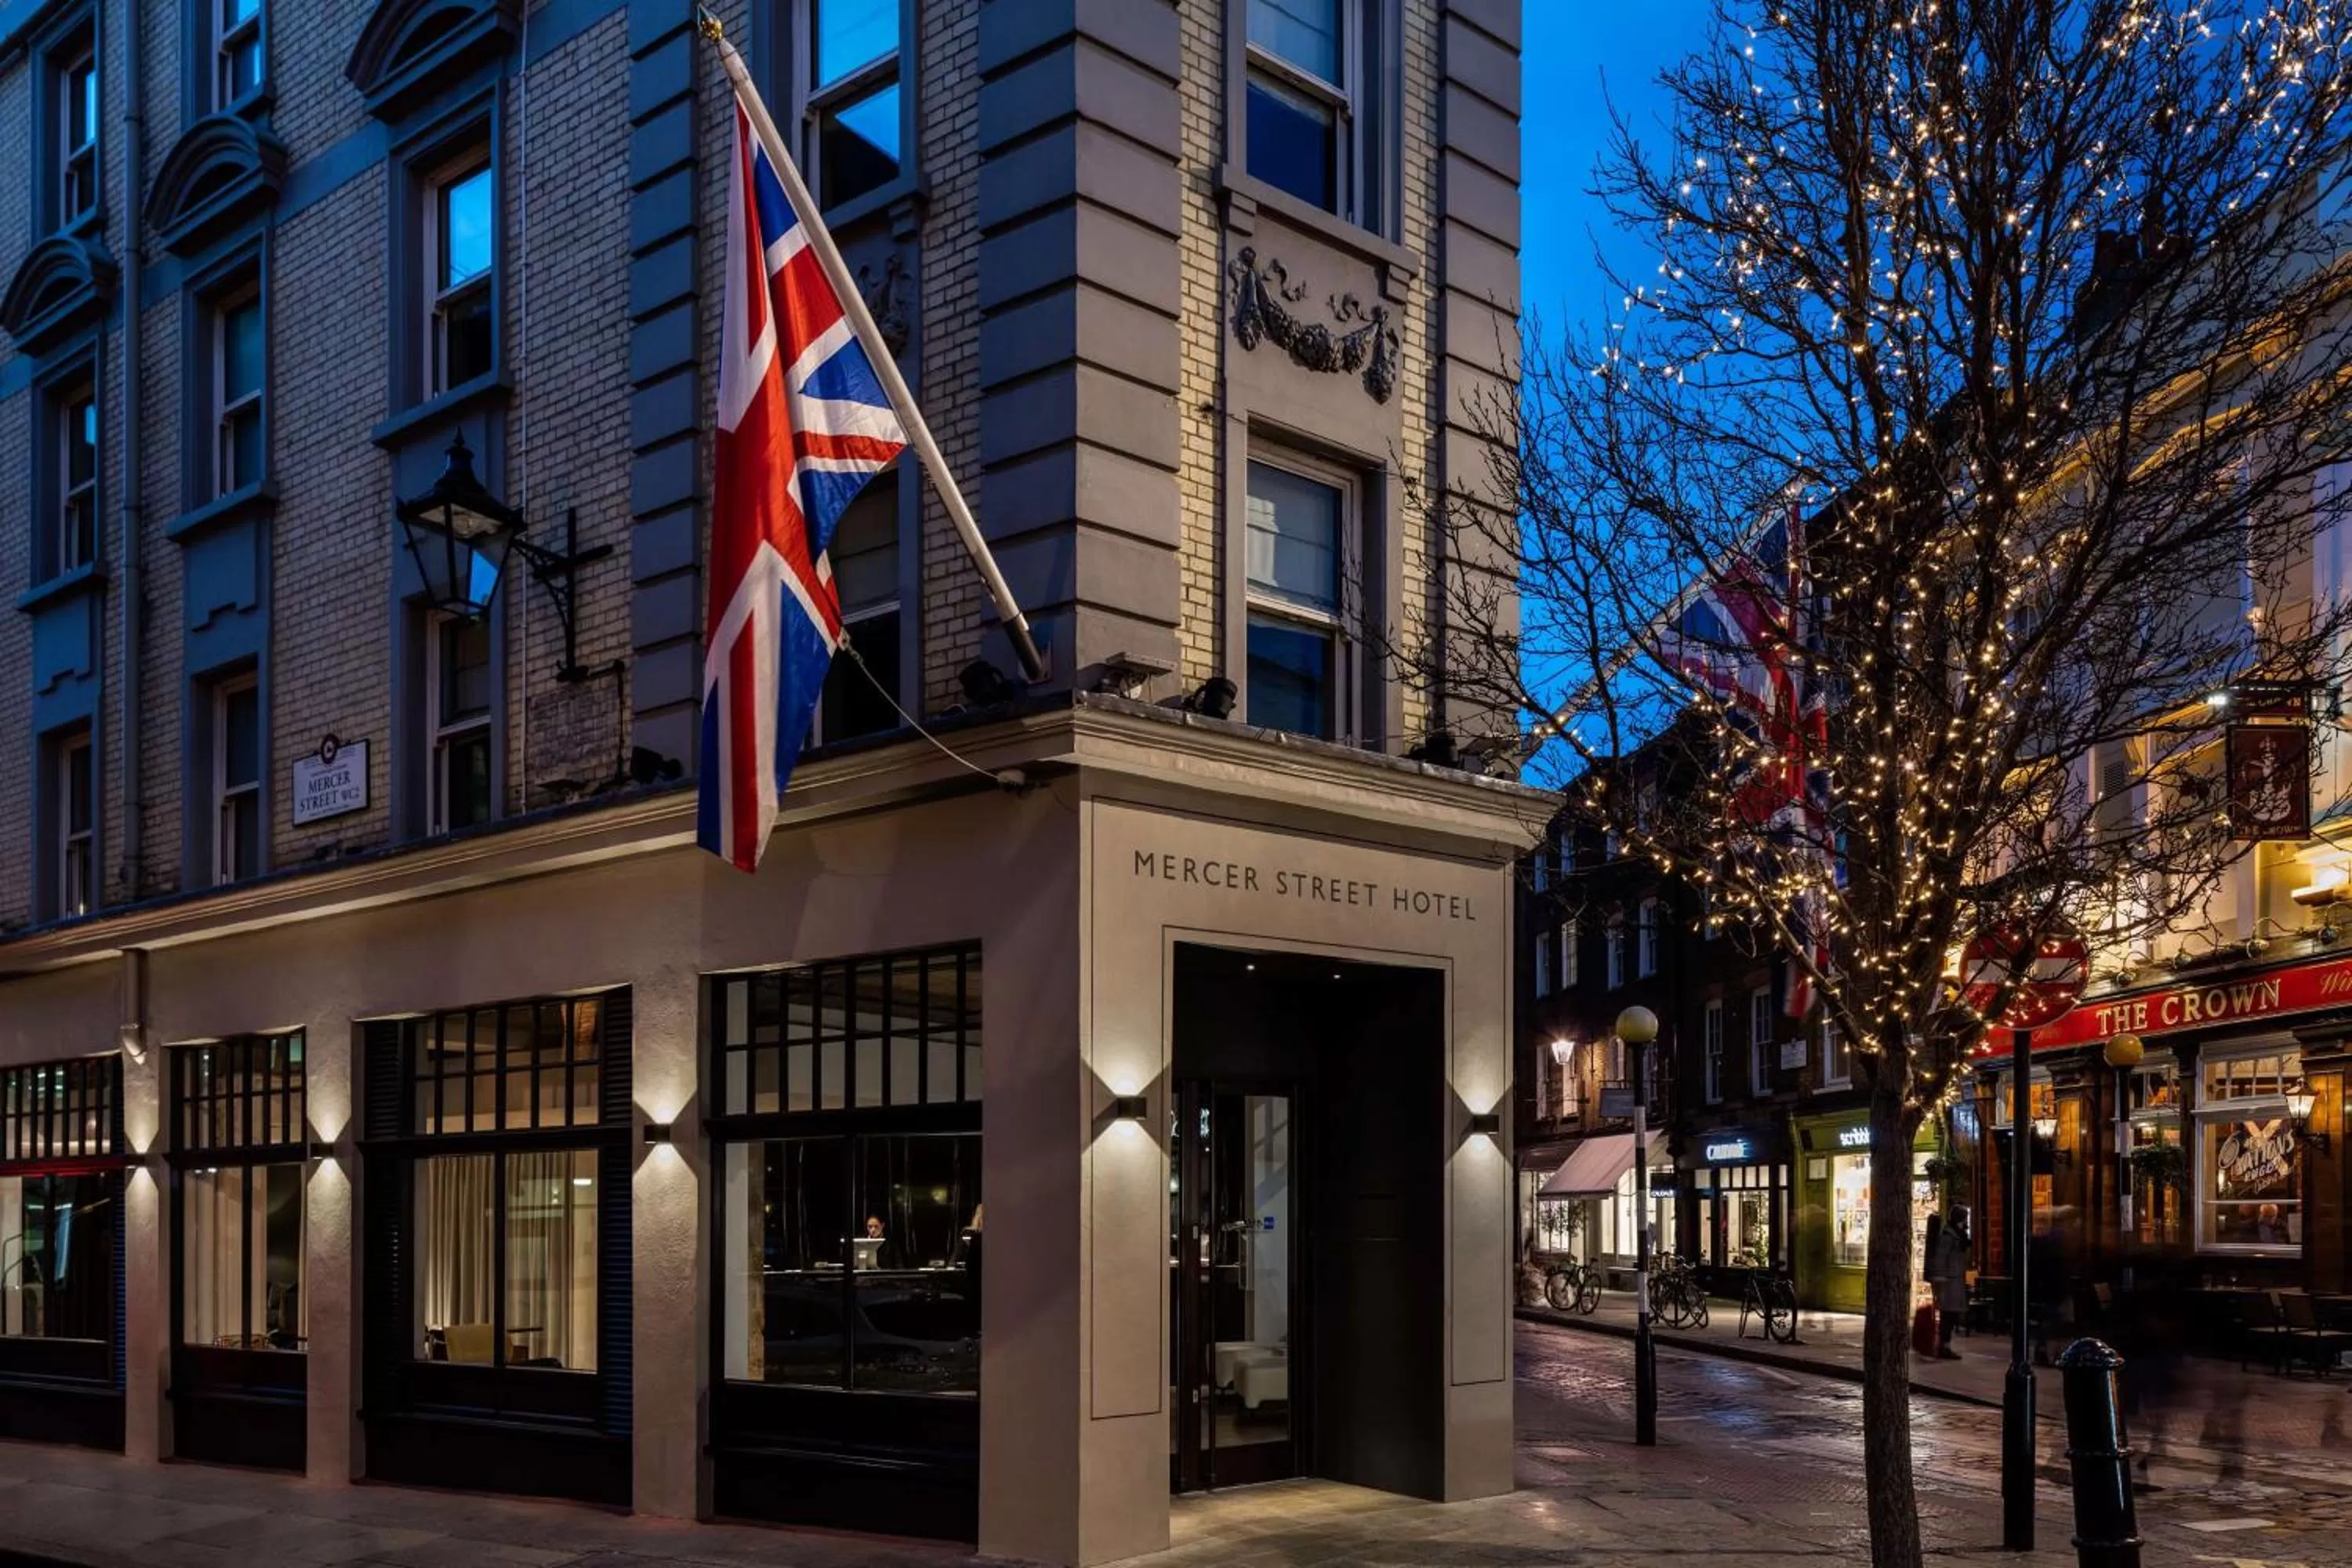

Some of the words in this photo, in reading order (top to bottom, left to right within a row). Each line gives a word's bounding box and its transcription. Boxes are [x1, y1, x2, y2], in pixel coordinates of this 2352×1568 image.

[300, 790, 339, 813] STREET
[309, 771, 351, 794] MERCER
[1134, 850, 1260, 891] MERCER
[1276, 870, 1378, 907] STREET
[1392, 887, 1477, 921] HOTEL
[2095, 1000, 2148, 1036] THE
[2161, 978, 2281, 1026] CROWN
